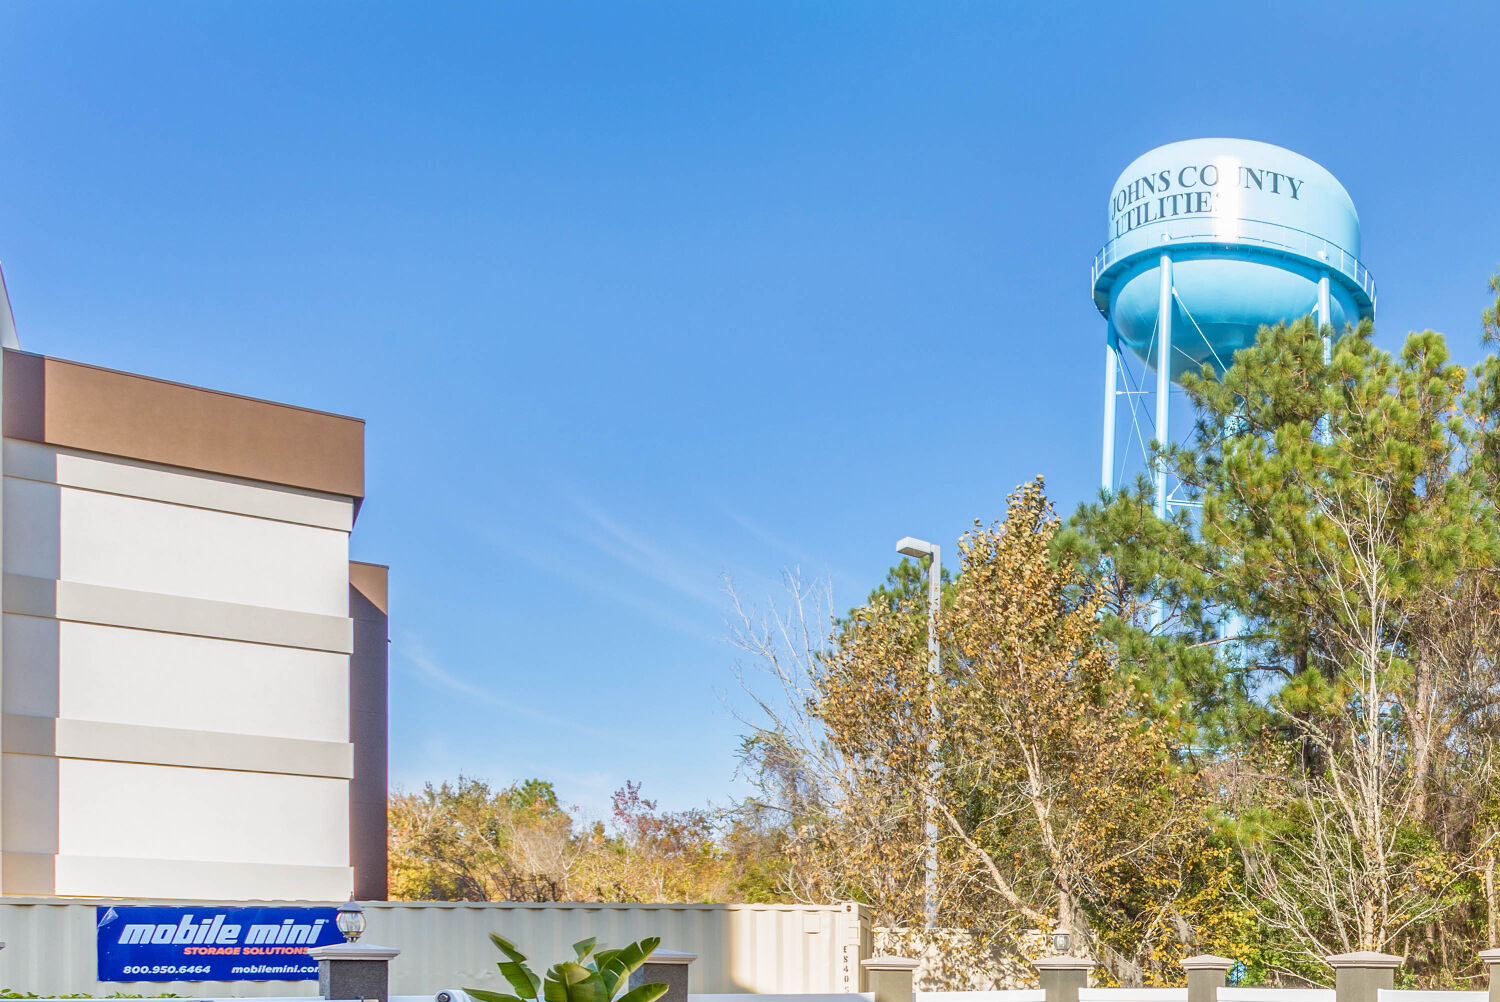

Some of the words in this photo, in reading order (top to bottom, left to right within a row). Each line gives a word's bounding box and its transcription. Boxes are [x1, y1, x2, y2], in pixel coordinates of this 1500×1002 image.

[1111, 169, 1171, 220] JOHNS
[1115, 191, 1223, 237] UTILITIE
[118, 915, 241, 944] mobile
[245, 919, 325, 944] mini
[184, 947, 240, 955] STORAGE
[243, 947, 309, 955] SOLUTIONS
[123, 965, 211, 974] 800.950.6464
